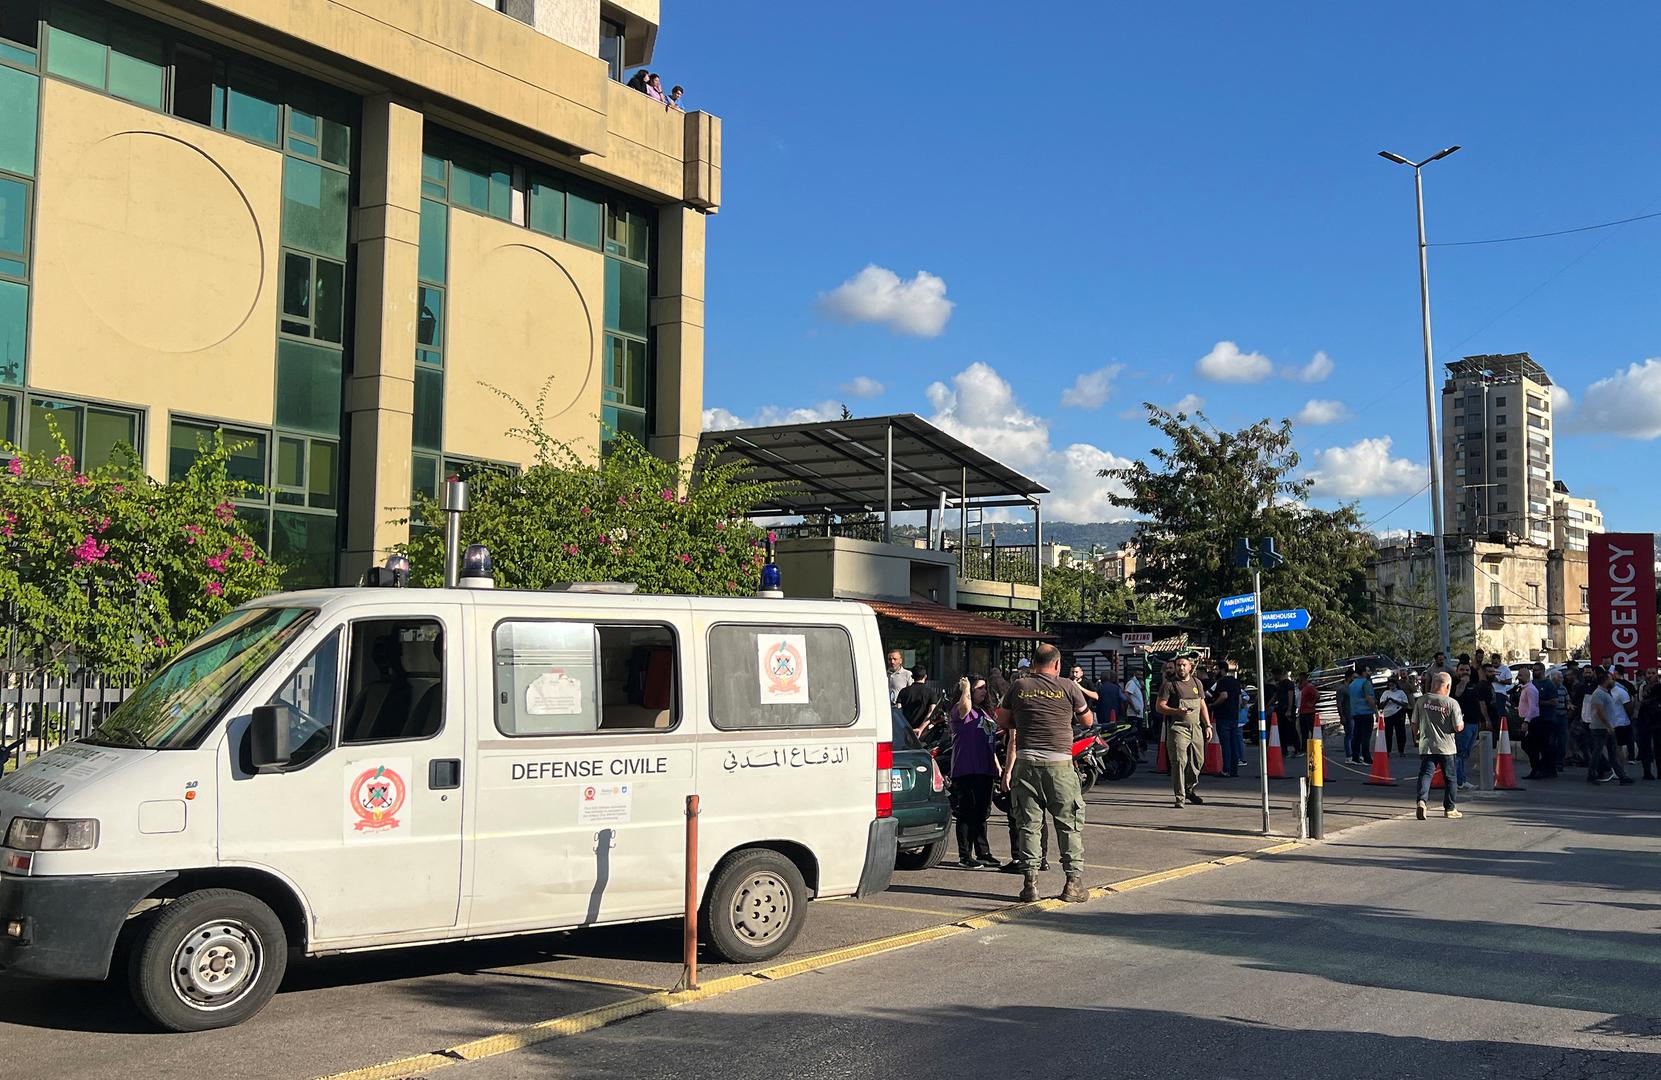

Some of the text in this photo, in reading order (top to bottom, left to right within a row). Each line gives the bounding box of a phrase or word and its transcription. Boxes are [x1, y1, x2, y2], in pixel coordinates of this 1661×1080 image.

[1223, 596, 1254, 607] MAIN ENTRANCE
[1262, 612, 1297, 620] WAREHOUSES
[1262, 621, 1289, 629] مستودعات
[511, 757, 668, 780] DEFENSE CIVILE
